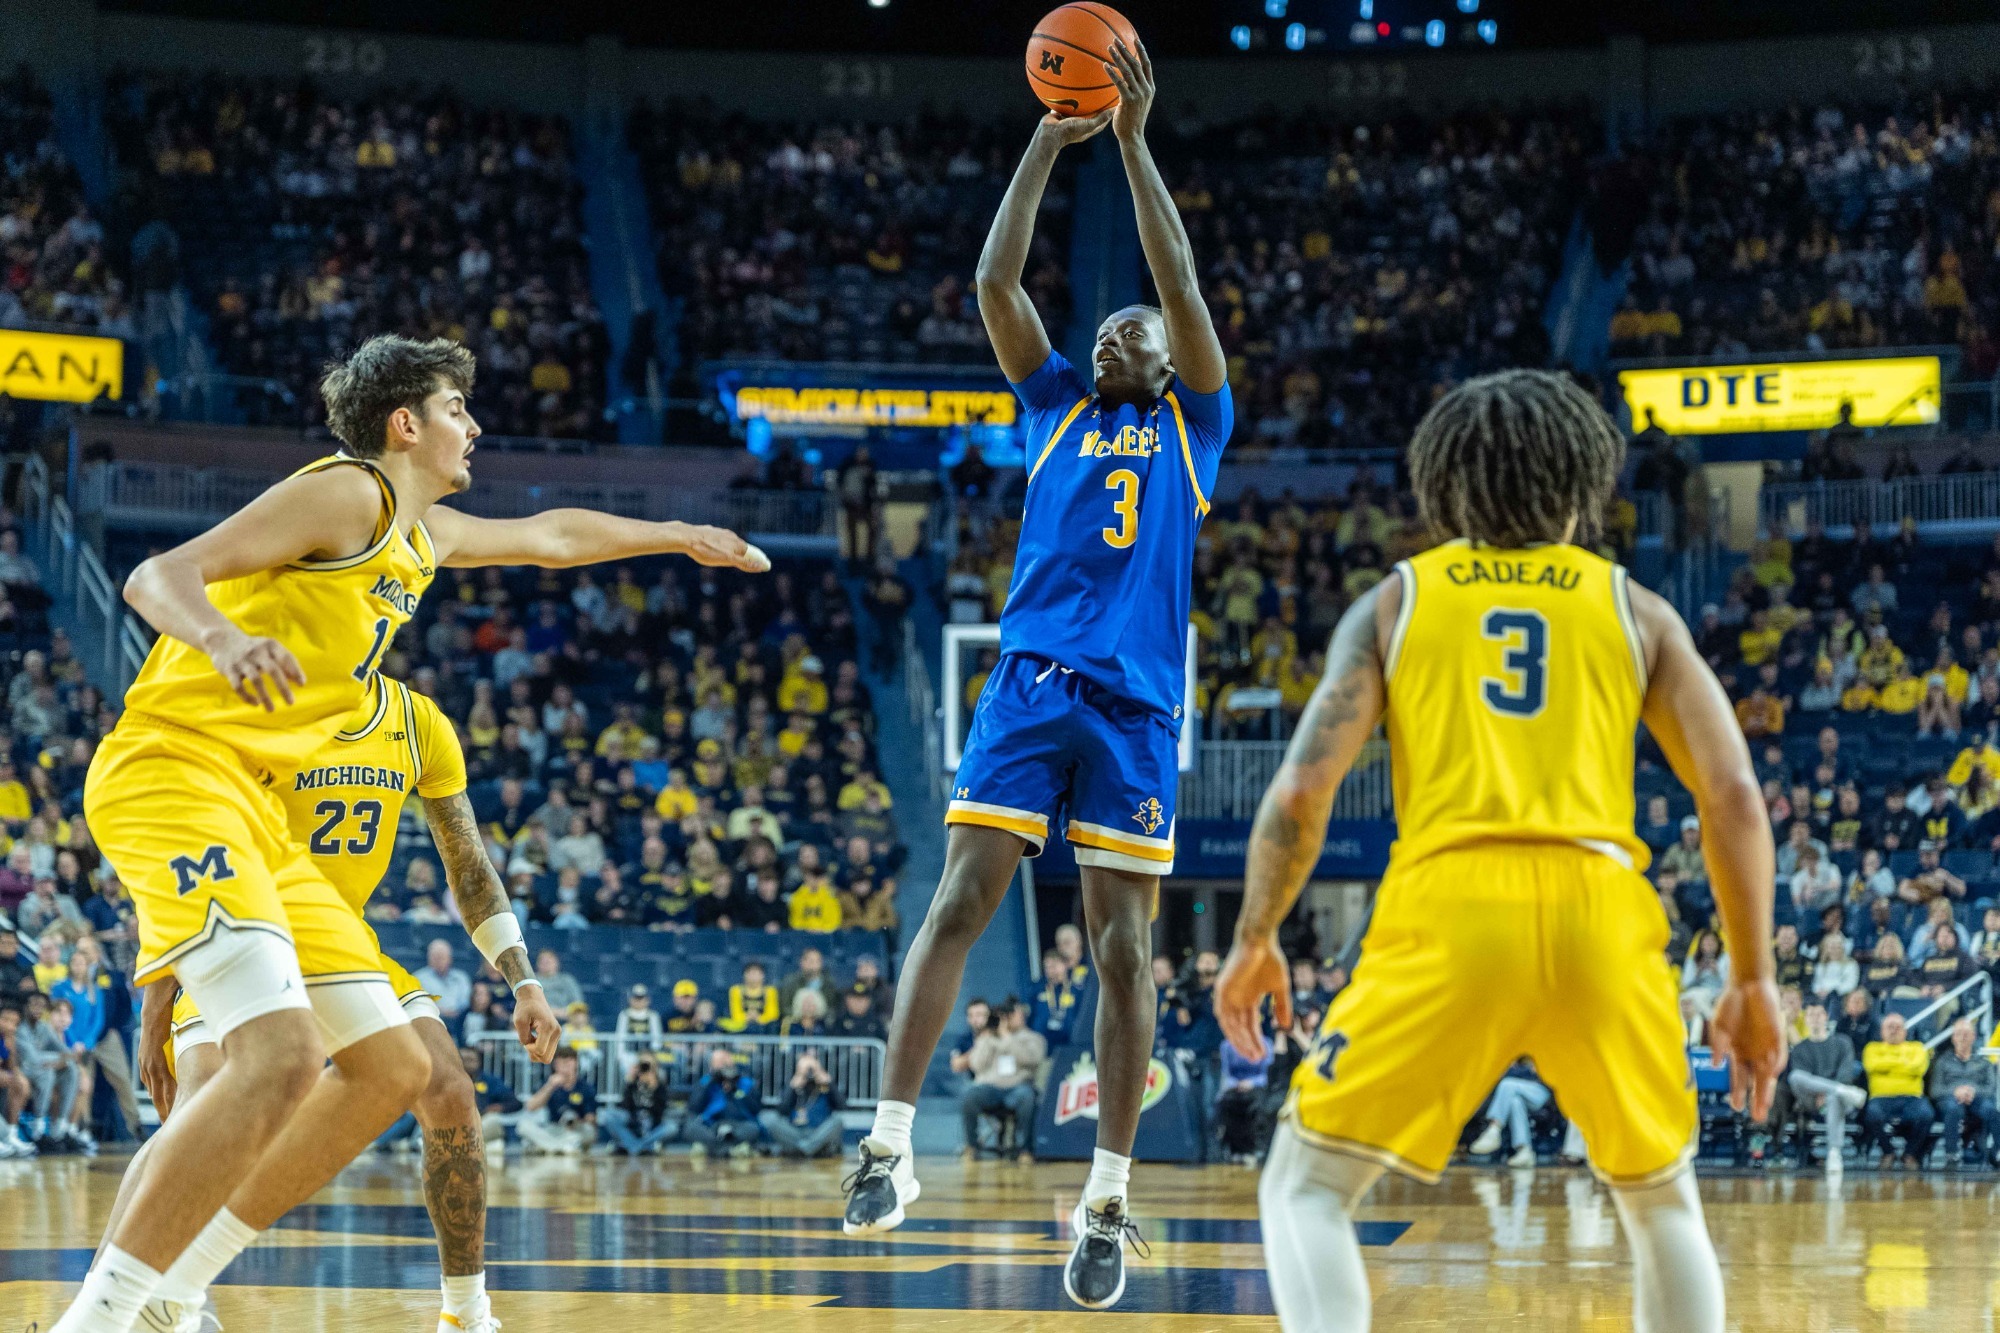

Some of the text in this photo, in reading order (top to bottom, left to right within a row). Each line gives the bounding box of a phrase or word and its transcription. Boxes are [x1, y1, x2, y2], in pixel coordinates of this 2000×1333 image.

[1852, 37, 1933, 76] 233
[1682, 373, 1779, 407] DTE
[1102, 468, 1140, 549] 3
[1445, 559, 1582, 591] CADEAU
[1480, 606, 1550, 720] 3
[293, 765, 406, 793] MICHIGAN
[309, 799, 384, 855] 23
[168, 844, 237, 898] M
[431, 1124, 477, 1144] WHY SO
